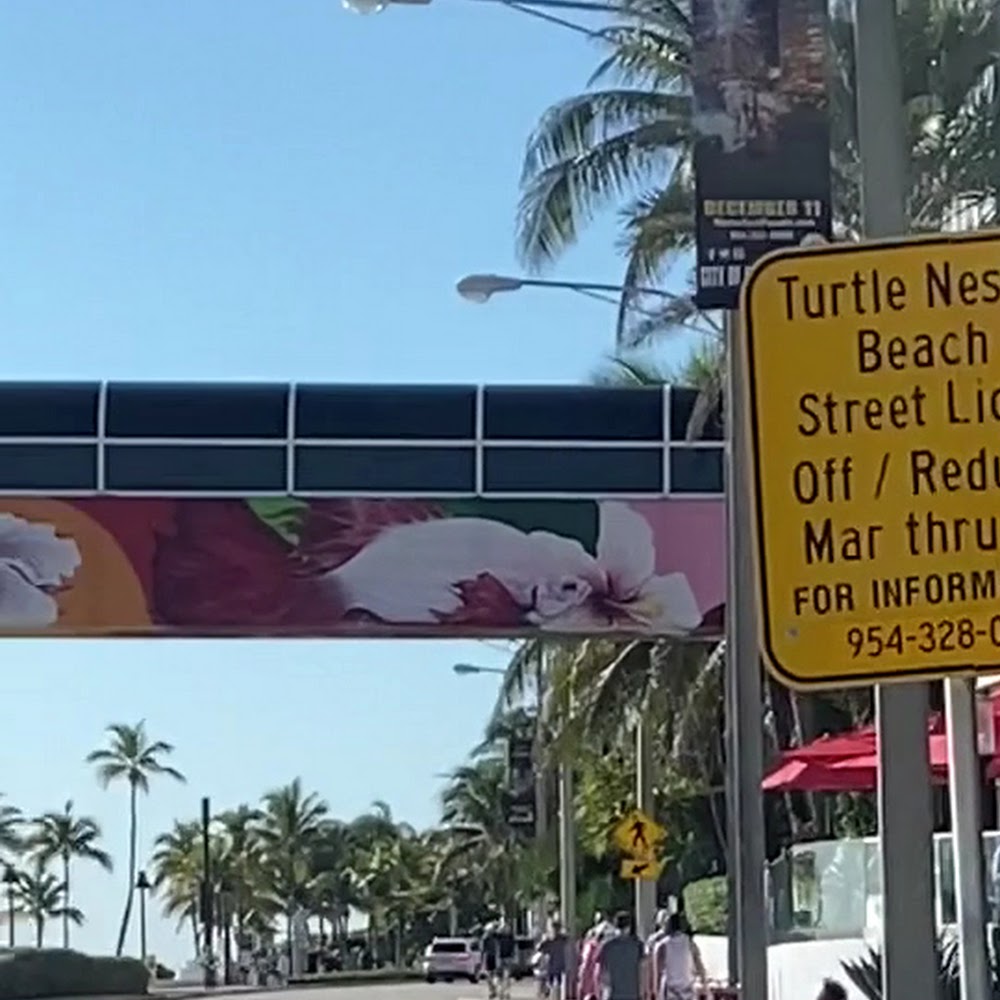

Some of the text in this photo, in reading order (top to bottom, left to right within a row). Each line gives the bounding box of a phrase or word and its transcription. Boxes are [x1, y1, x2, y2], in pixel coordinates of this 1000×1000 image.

[777, 269, 906, 320] Turtle
[858, 322, 987, 373] Beach
[798, 386, 926, 436] Street
[794, 456, 852, 504] Off
[875, 453, 889, 498] /
[805, 518, 883, 564] Mar
[906, 511, 997, 555] thru
[794, 583, 854, 616] FOR
